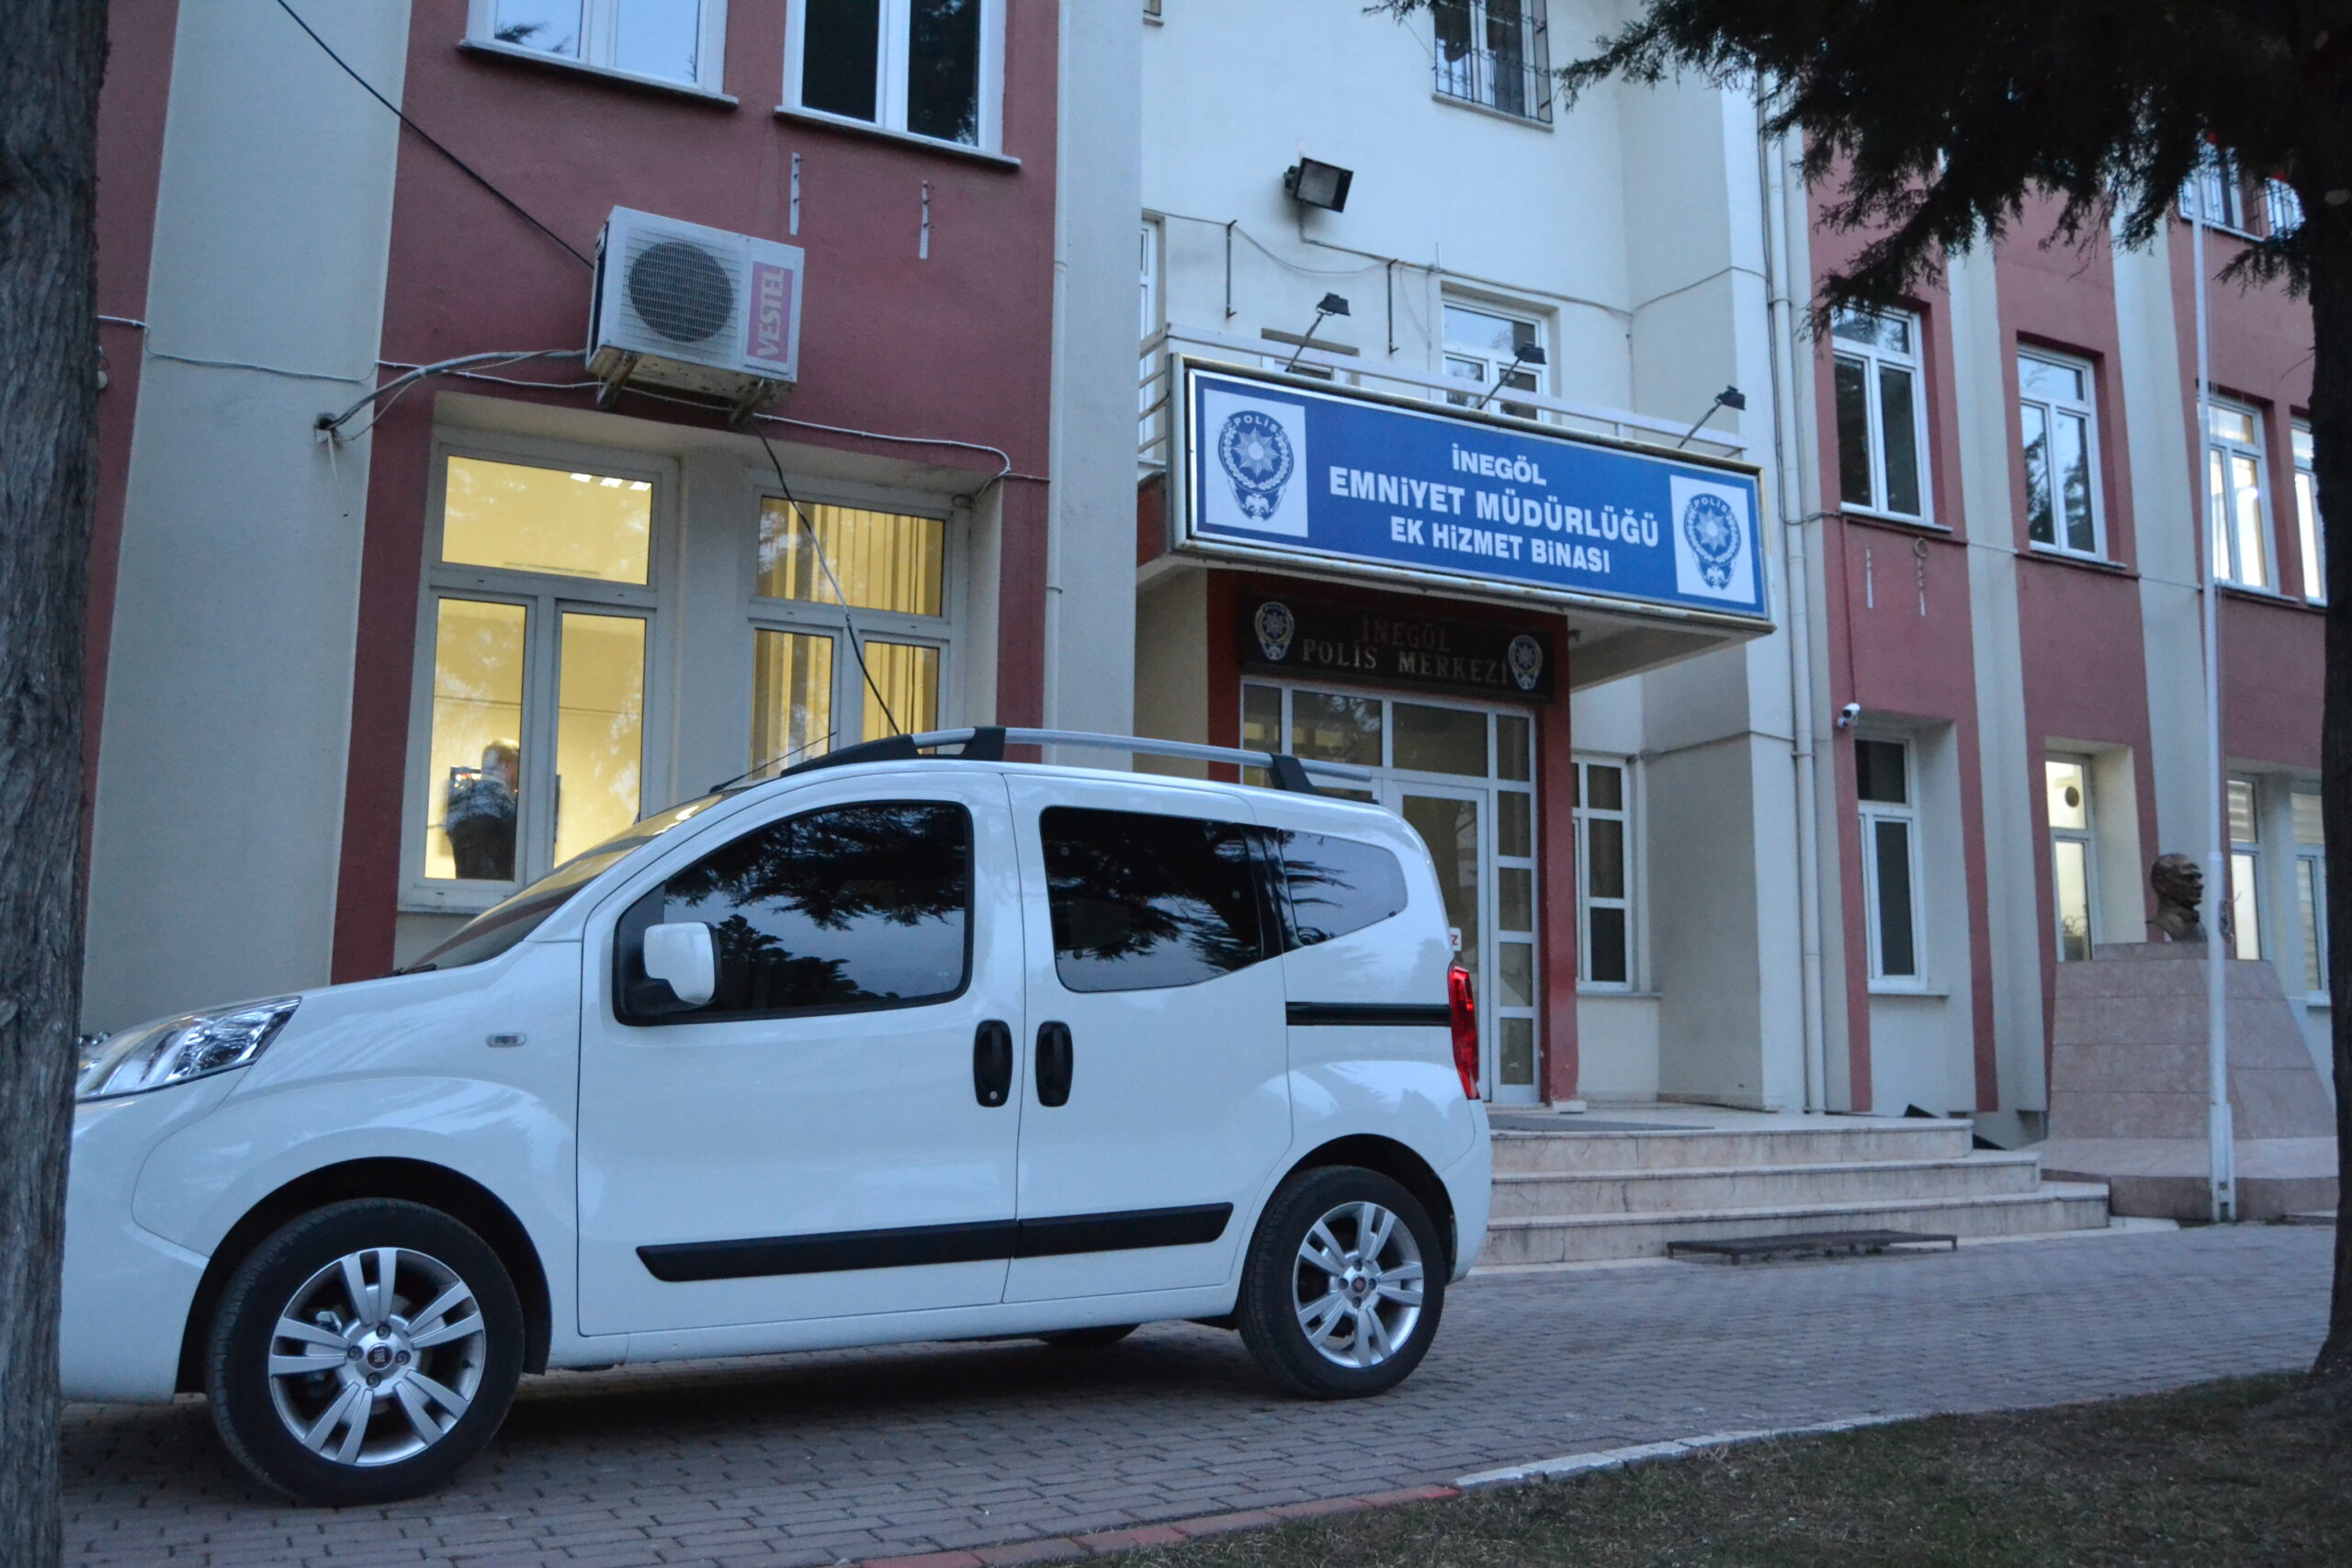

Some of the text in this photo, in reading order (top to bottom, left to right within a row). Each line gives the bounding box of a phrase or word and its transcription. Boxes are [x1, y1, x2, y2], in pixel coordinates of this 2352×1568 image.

[757, 269, 785, 356] VESTEL
[1452, 443, 1546, 487] İNEGÖL
[1329, 467, 1659, 547] EMNİYET MÜDÜRLÜĞÜ
[1391, 515, 1611, 573] EK HİZMET BİNASI
[1363, 614, 1451, 652] İNEGÖL
[1301, 638, 1509, 684] POLİS MERKEZİ
